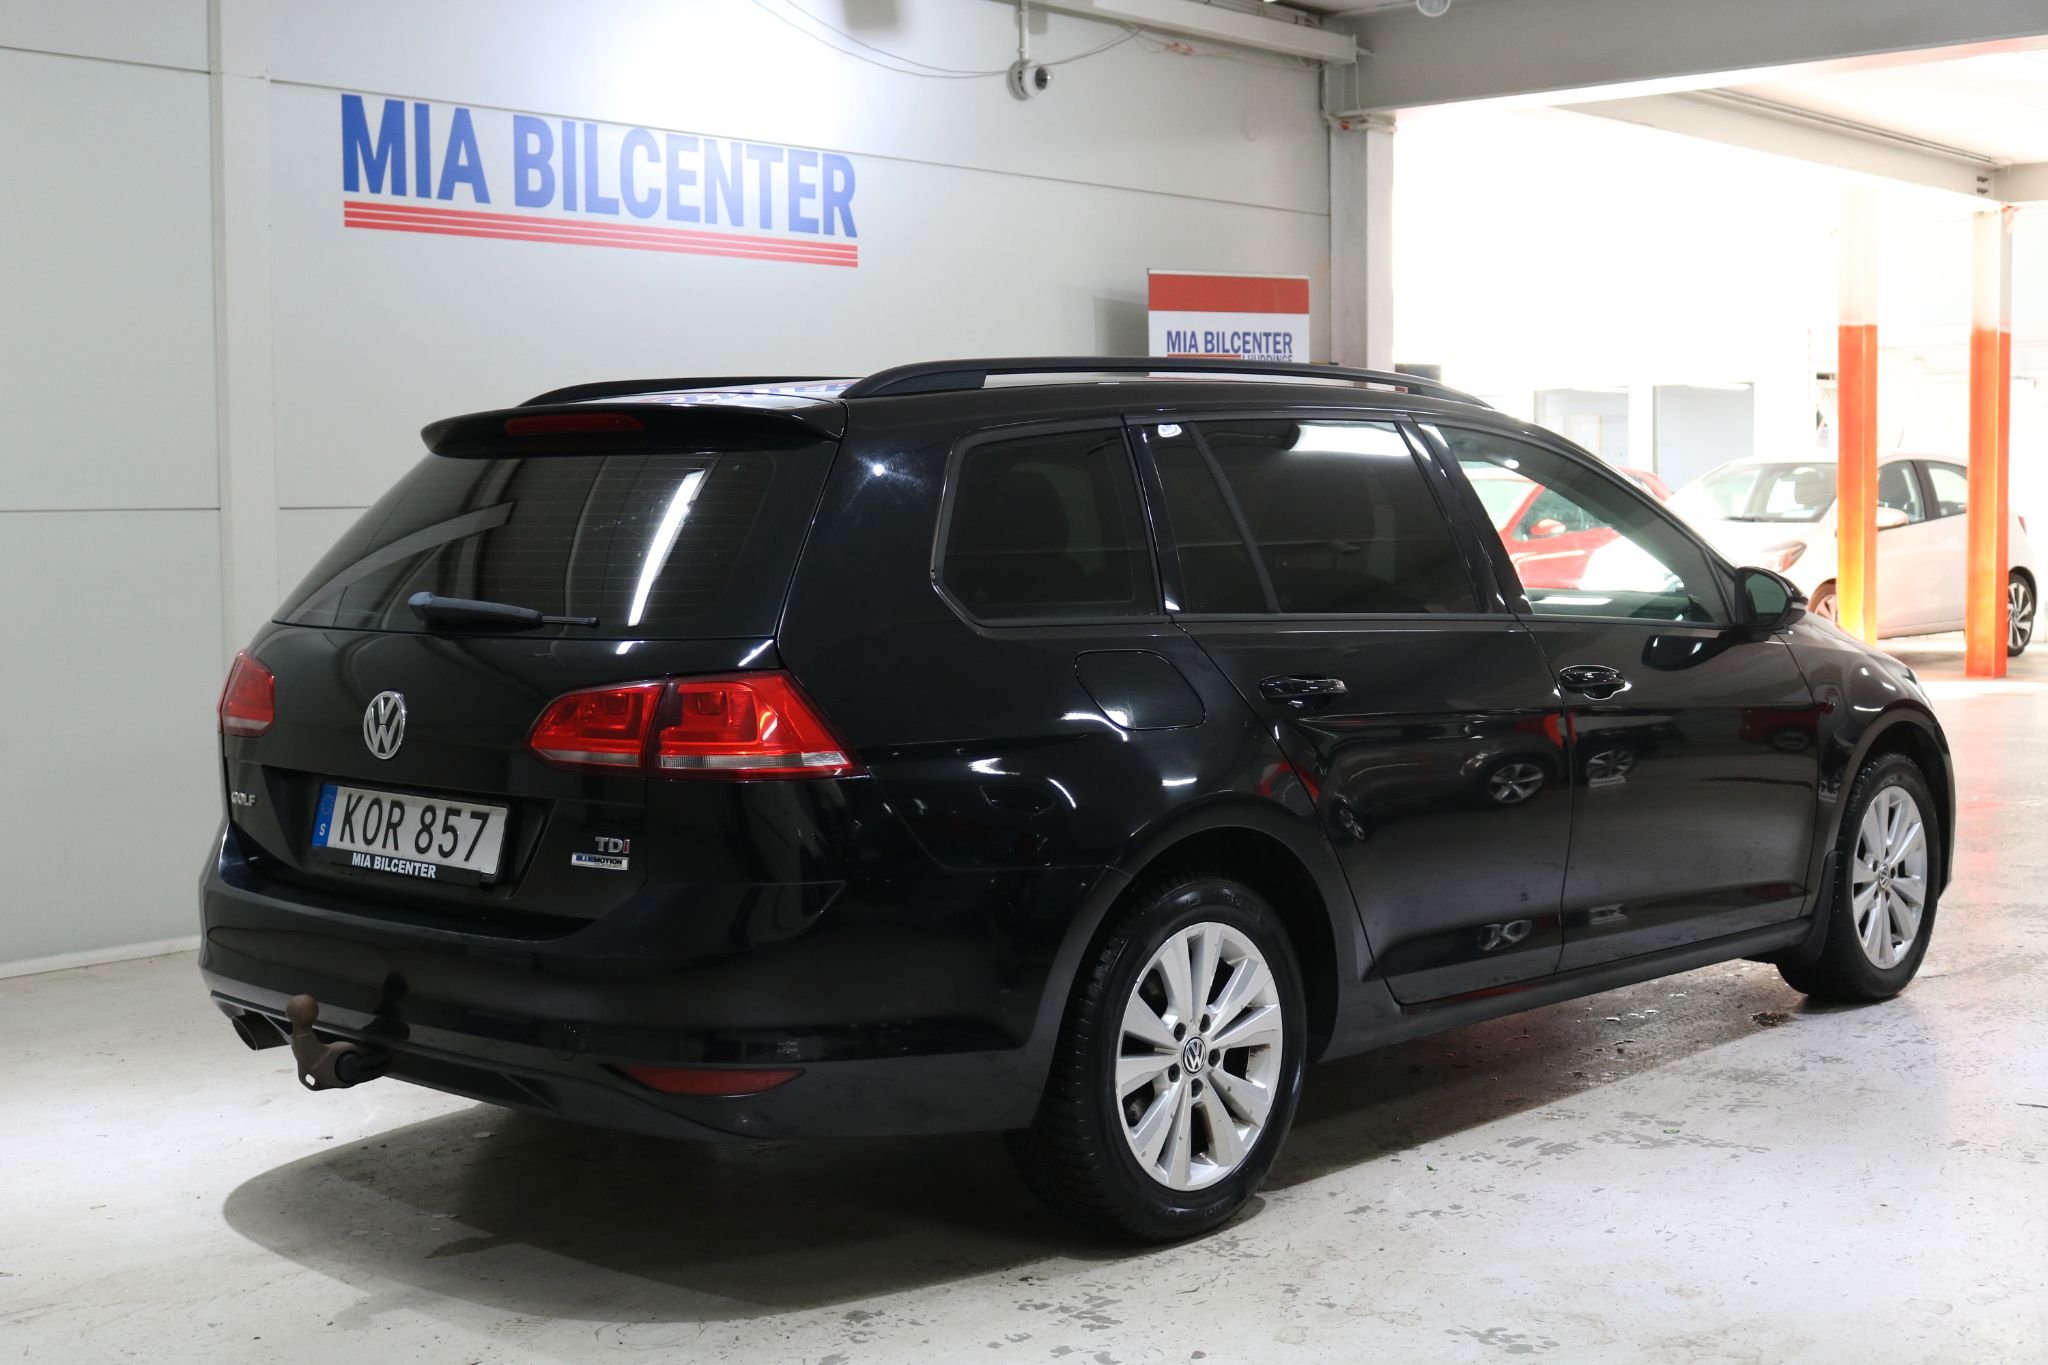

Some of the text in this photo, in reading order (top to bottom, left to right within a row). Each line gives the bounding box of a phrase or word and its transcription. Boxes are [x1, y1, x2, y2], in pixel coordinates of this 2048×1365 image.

[341, 93, 858, 238] MIA BILCENTER
[1166, 330, 1293, 354] MIA BILCENTER
[231, 791, 256, 806] GOLF
[319, 823, 326, 836] S
[339, 793, 490, 862] KOR 857
[351, 852, 437, 879] MIA BILCENTER
